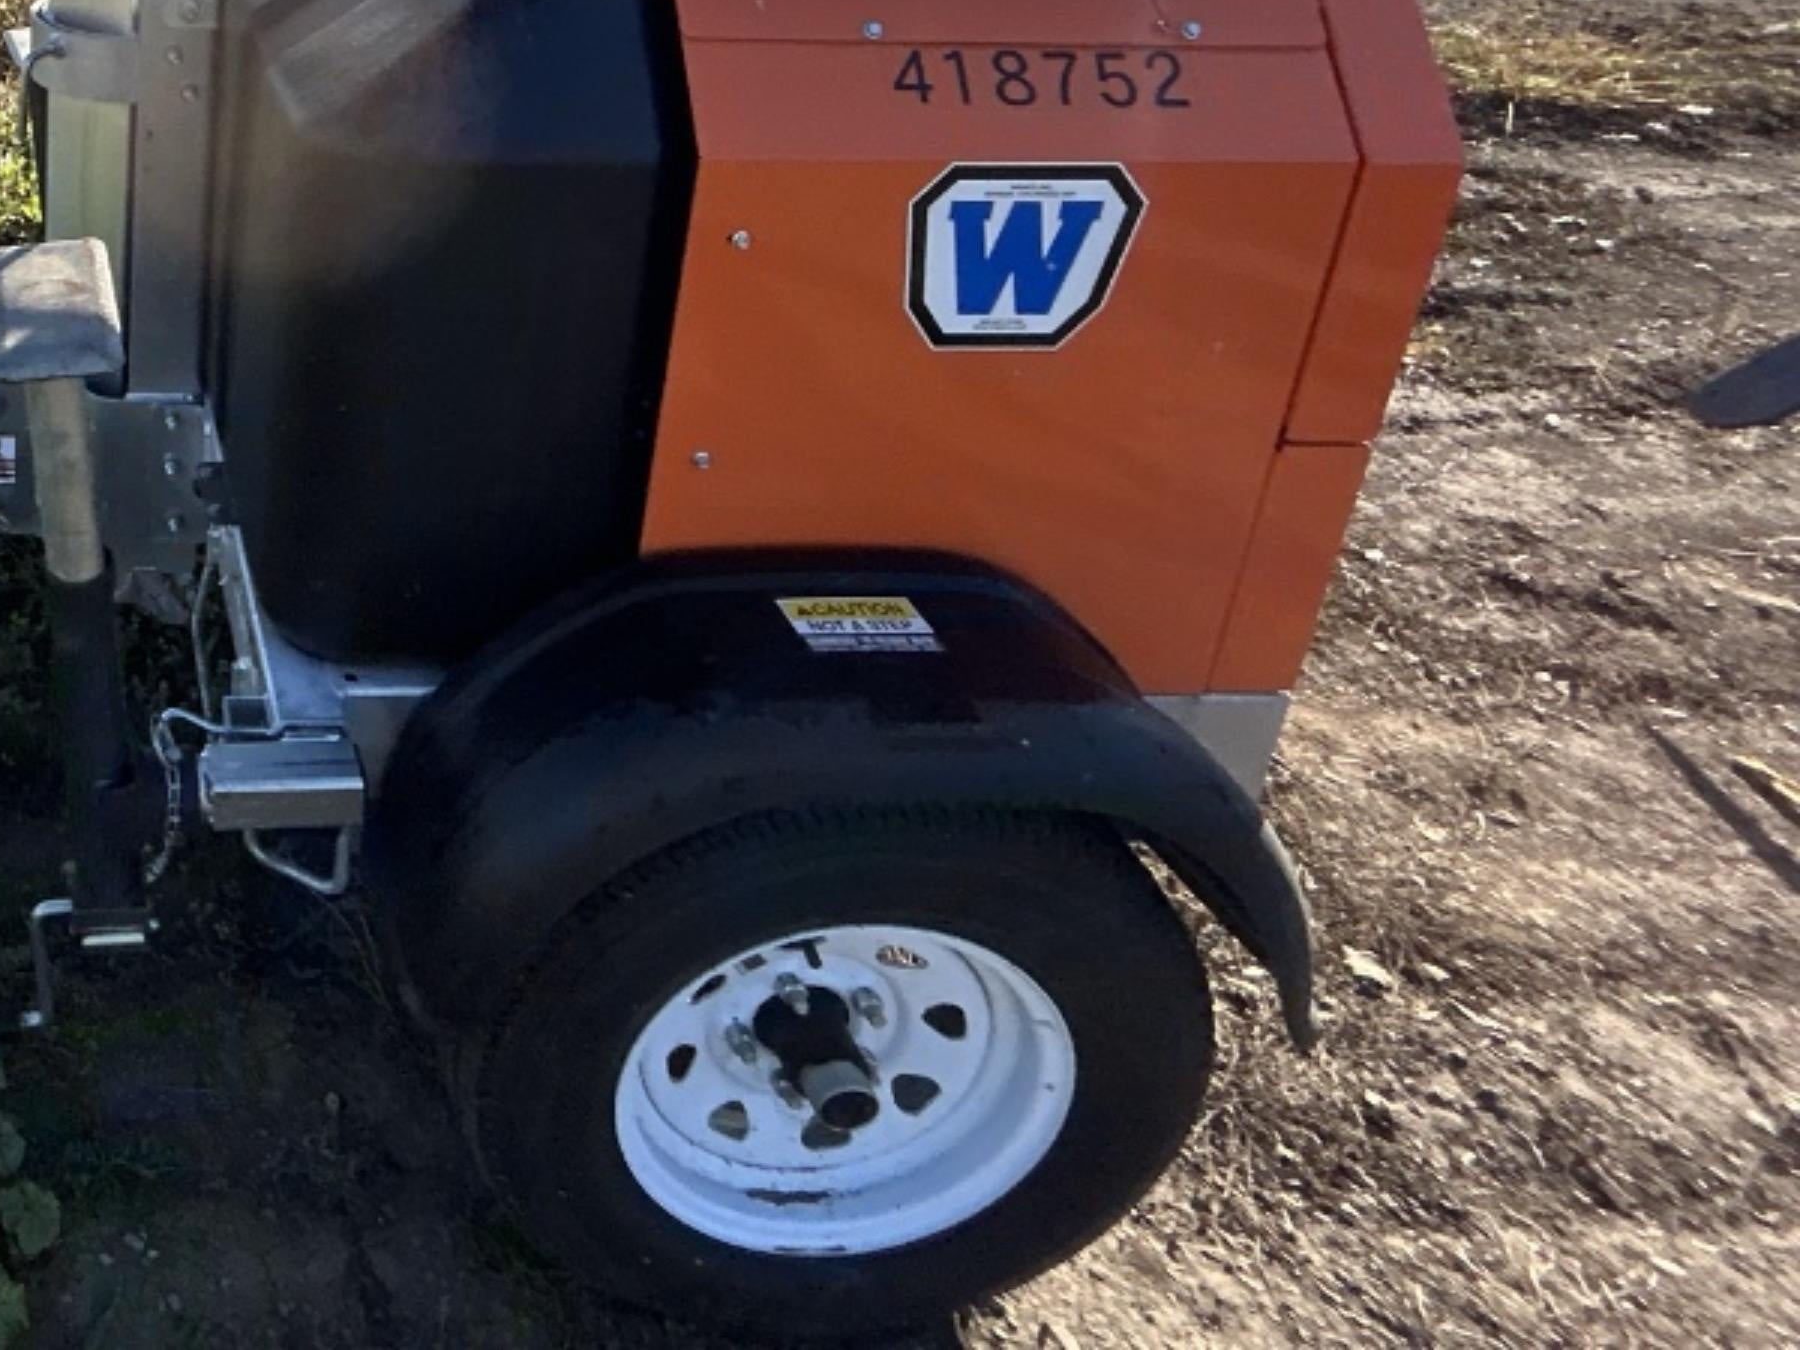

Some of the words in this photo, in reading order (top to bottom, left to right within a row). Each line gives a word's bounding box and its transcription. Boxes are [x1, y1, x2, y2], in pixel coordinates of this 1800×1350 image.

[893, 50, 1190, 108] 418752
[947, 200, 1105, 315] W
[812, 602, 906, 616] CAUTION
